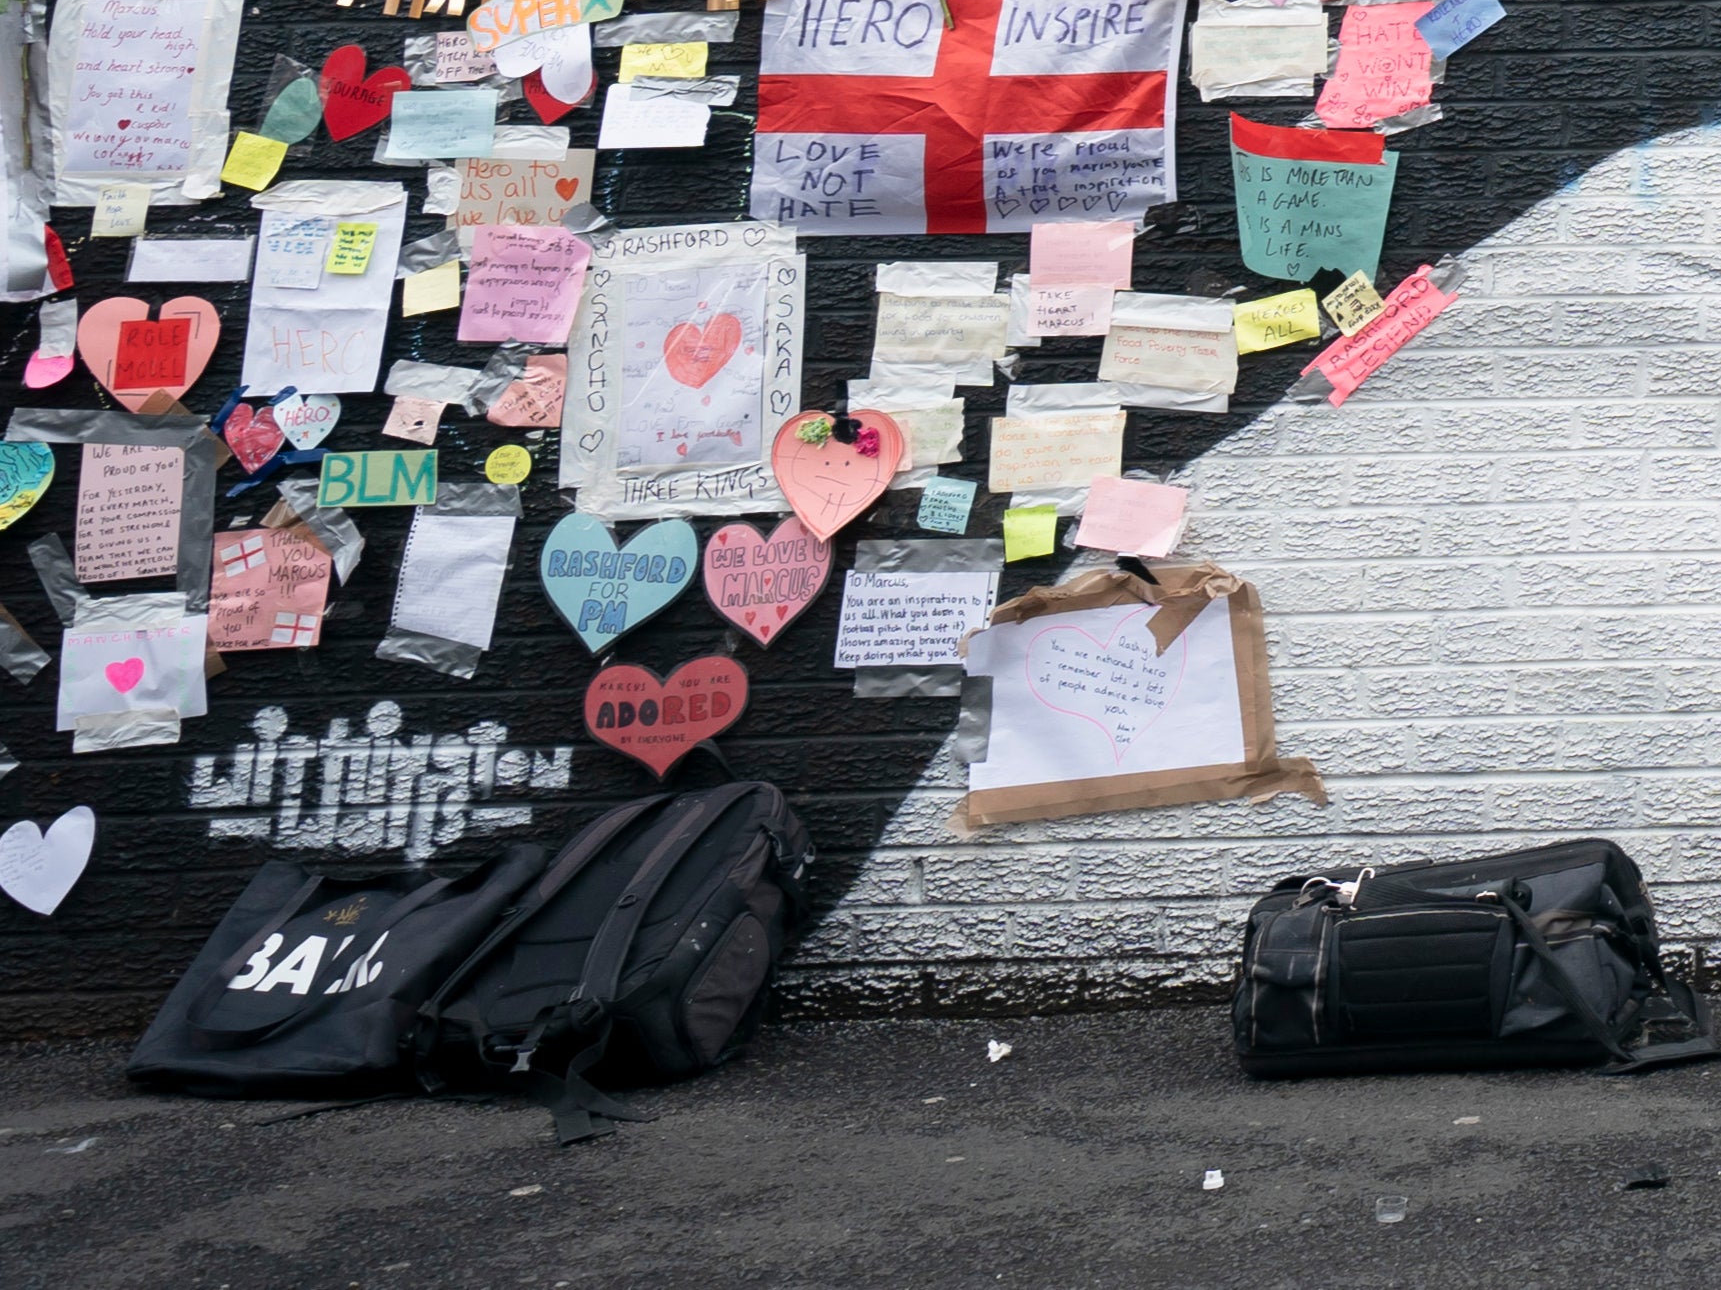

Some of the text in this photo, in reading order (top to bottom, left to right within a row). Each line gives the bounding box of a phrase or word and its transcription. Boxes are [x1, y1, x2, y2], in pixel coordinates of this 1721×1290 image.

[81, 22, 183, 48] Hold your head
[1004, 0, 1149, 47] INSPIRE
[1356, 22, 1422, 45] HATE
[76, 59, 186, 79] and heart strong
[327, 77, 385, 107] COURAGE
[776, 140, 880, 163] LOVE
[467, 158, 559, 180] Hero to
[1287, 169, 1329, 186] MORE
[460, 177, 536, 201] us all
[802, 169, 875, 195] NOT
[779, 198, 880, 221] HATE
[622, 229, 729, 256] RASHFORD
[1264, 321, 1304, 340] ALL
[1329, 275, 1430, 370] RASHFORD
[319, 454, 436, 505] BLM
[622, 477, 680, 504] THREE
[282, 547, 315, 562] YOU
[547, 549, 687, 585] RASHFORD
[711, 547, 745, 569] WE
[754, 540, 802, 567] LOVE
[268, 564, 326, 583] MARCUS
[848, 573, 861, 587] To
[589, 582, 629, 600] FOR
[721, 567, 820, 609] MARCUS
[846, 595, 863, 608] You
[868, 598, 884, 606] are
[905, 593, 967, 608] inspiration
[972, 596, 981, 606] to
[577, 600, 628, 635] PM
[596, 691, 731, 729] ADORED
